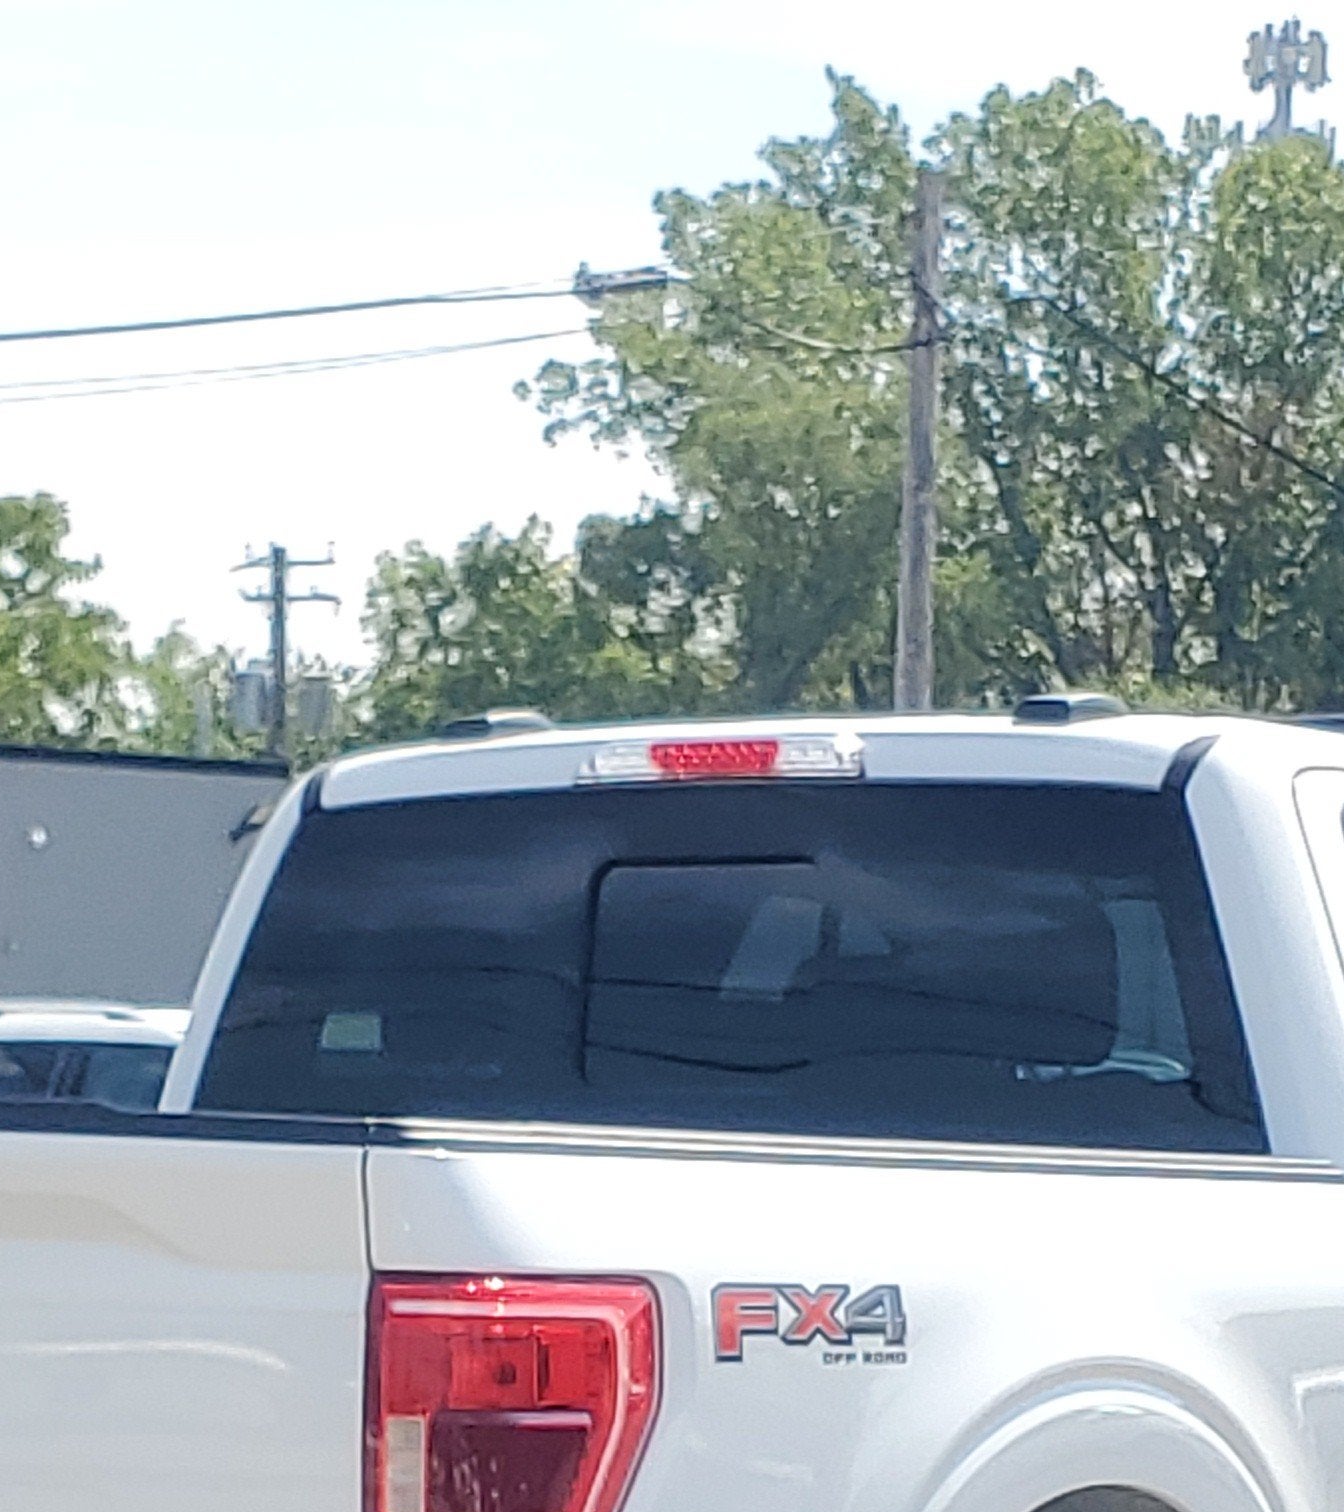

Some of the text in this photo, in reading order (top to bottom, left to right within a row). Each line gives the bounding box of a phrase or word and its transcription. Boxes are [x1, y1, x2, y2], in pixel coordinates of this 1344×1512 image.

[711, 1282, 906, 1362] FX4
[823, 1352, 907, 1366] OFF ROAD
